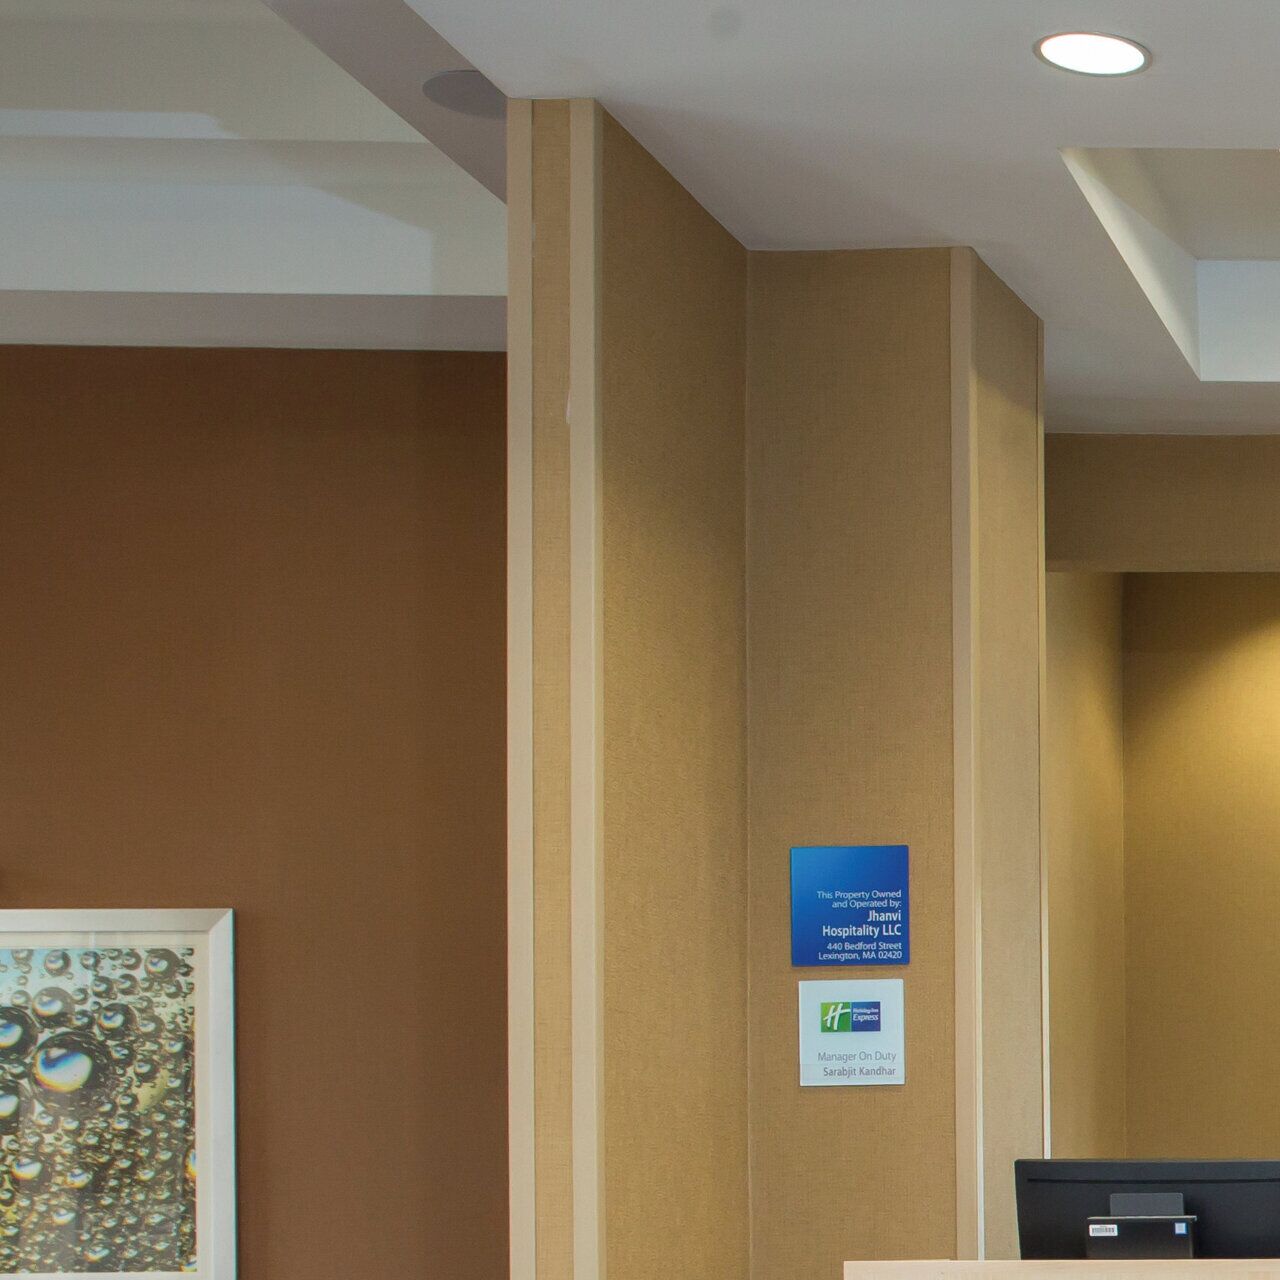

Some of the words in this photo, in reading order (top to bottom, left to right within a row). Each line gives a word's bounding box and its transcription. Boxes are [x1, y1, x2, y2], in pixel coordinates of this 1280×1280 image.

[835, 891, 870, 900] Property
[872, 890, 901, 898] Owned
[850, 900, 888, 909] Operated
[890, 900, 901, 908] by:
[867, 910, 901, 922] Jhanvi
[822, 925, 879, 938] Hospitality
[883, 925, 901, 935] LLC
[845, 942, 876, 950] Bedford
[879, 942, 902, 950] Street
[819, 952, 860, 961] Lexington,
[878, 951, 902, 959] 02420
[853, 1014, 879, 1022] Express
[818, 1052, 857, 1063] Manager
[859, 1052, 872, 1061] On
[874, 1051, 896, 1063] Duty
[823, 1067, 856, 1078] Sarabjit
[859, 1067, 896, 1076] Kandhar
